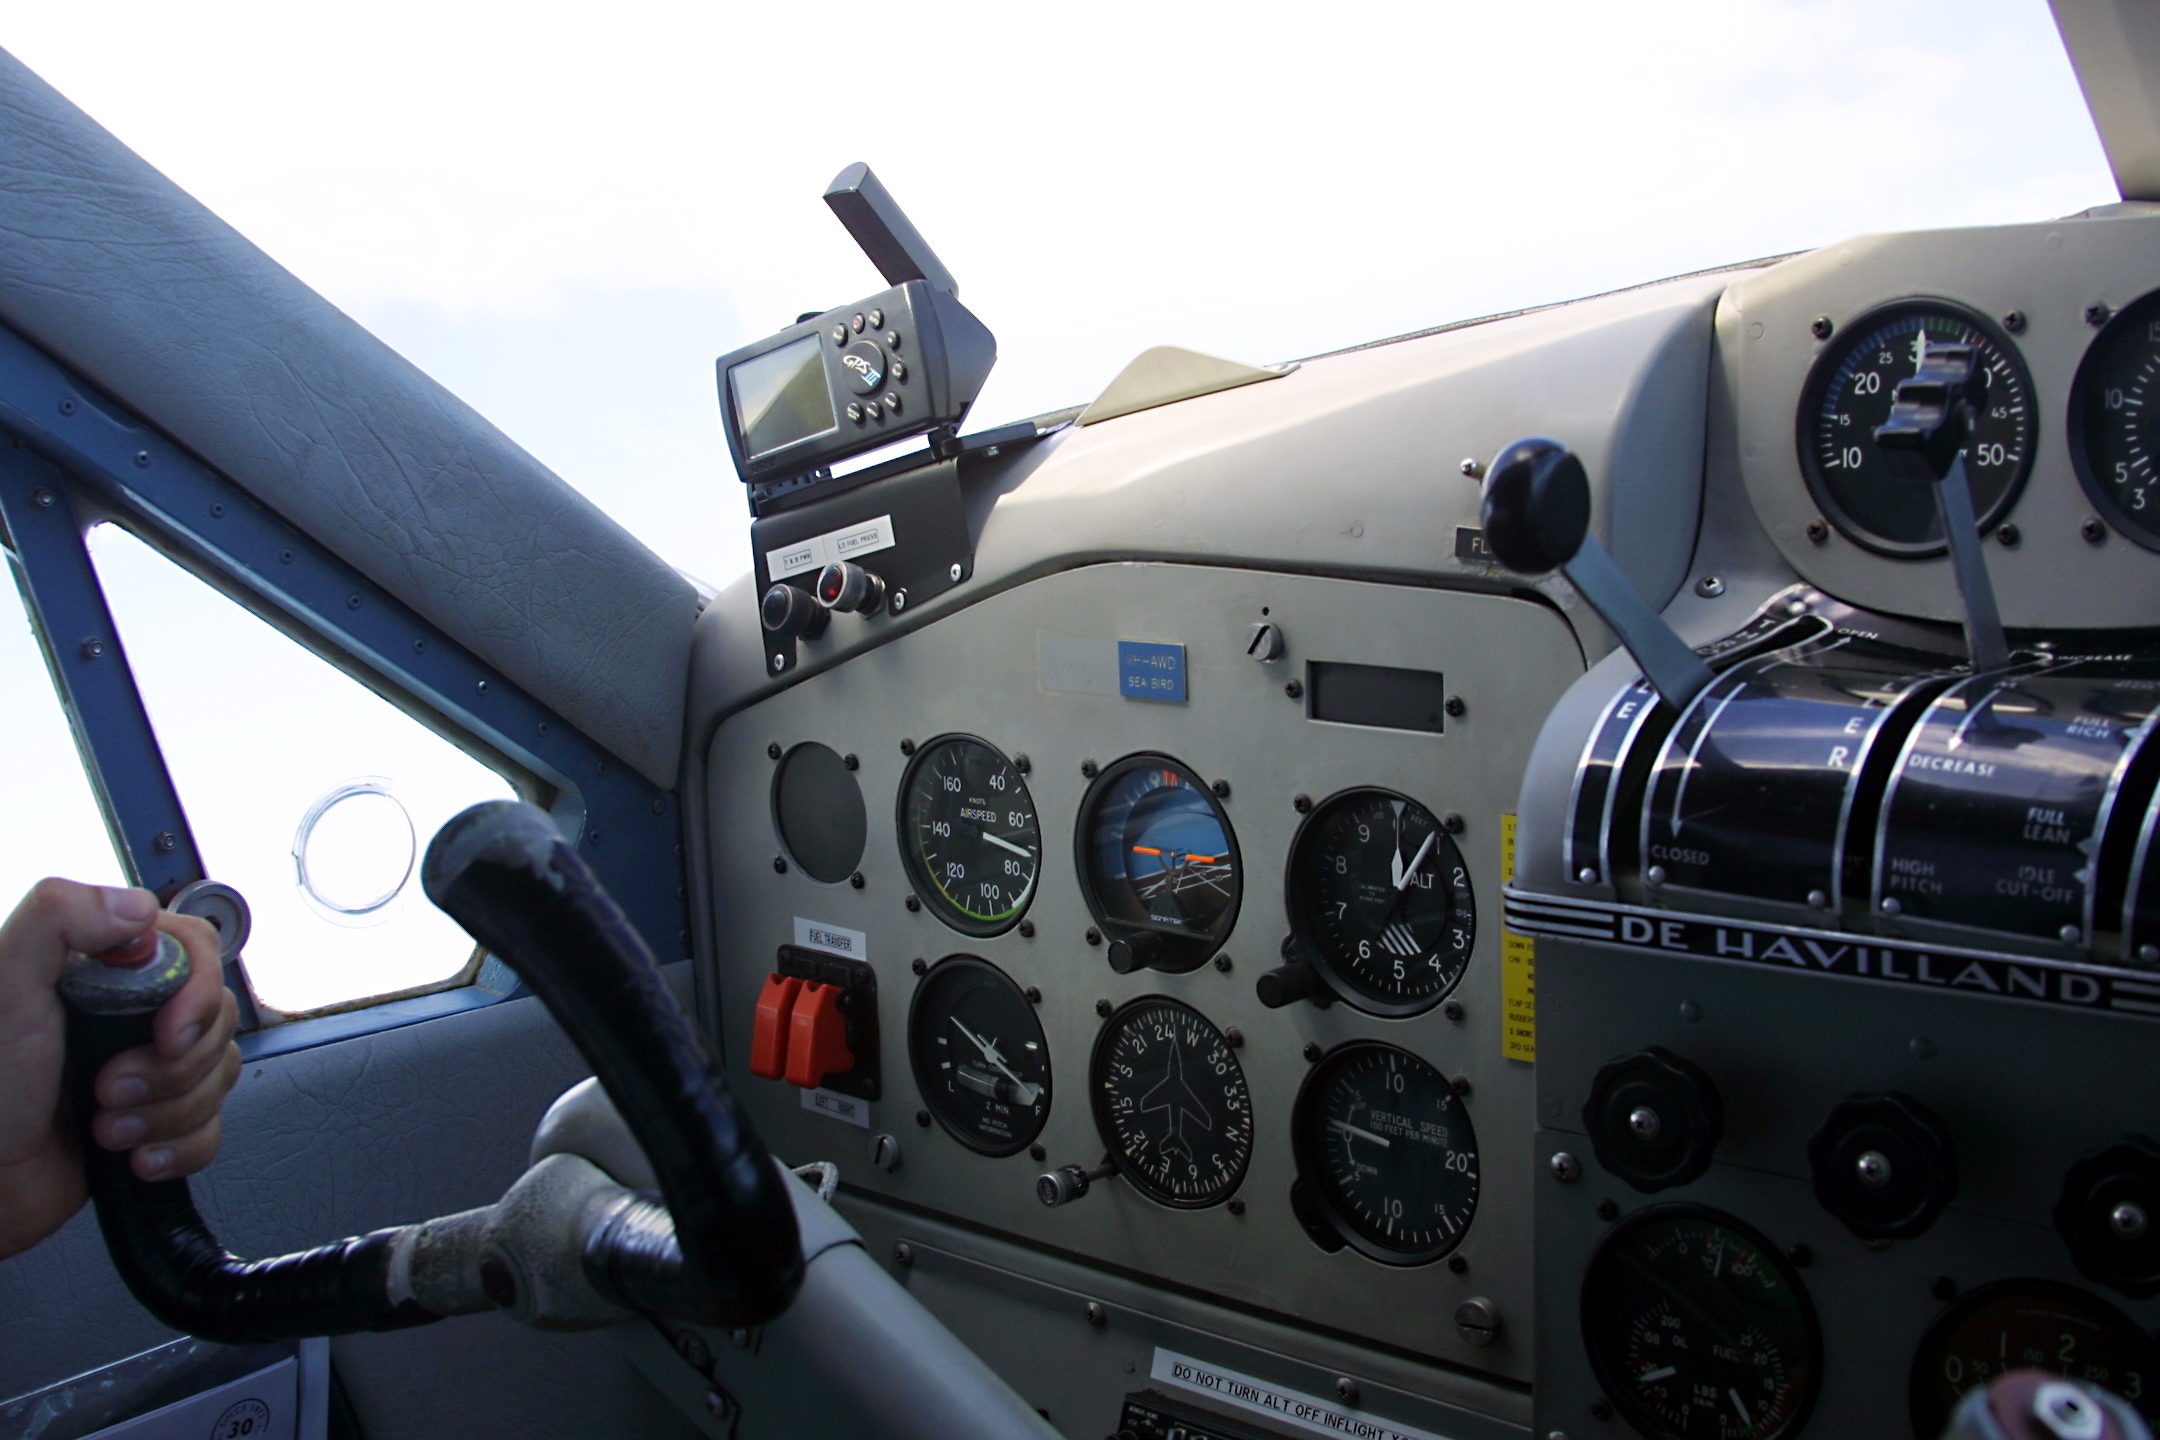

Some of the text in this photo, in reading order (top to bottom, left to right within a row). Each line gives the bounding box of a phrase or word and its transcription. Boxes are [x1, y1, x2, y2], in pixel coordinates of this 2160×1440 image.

[843, 355, 871, 374] GPS
[1879, 352, 1893, 364] 25
[1854, 372, 1880, 394] 20
[2105, 388, 2123, 410] 10
[1840, 414, 1851, 426] 15
[1842, 446, 1862, 468] 10
[1977, 443, 2004, 466] 50
[2114, 462, 2128, 484] 5
[2132, 488, 2145, 510] 3
[1837, 628, 1879, 640] OPEN
[1128, 676, 1174, 691] SEA BIRD
[2066, 724, 2110, 739] RICH
[1909, 752, 1997, 778] DECREASE
[943, 775, 961, 793] 160
[989, 775, 1005, 790] 40
[960, 807, 997, 823] AIRSPEED
[1008, 811, 1024, 828] 60
[2026, 806, 2067, 827] FULL
[932, 820, 950, 837] 140
[1358, 823, 1370, 843] 9
[2022, 823, 2070, 845] LEAN
[1336, 855, 1347, 874] 8
[1650, 844, 1710, 866] CLOSED
[946, 862, 965, 879] 120
[1004, 860, 1020, 876] 80
[1453, 866, 1465, 887] 2
[1892, 857, 1936, 877] HIGH
[2018, 864, 2056, 885] IDLE
[1409, 870, 1434, 889] ALT
[1890, 874, 1943, 896] PITCH
[980, 883, 1000, 900] 100
[1996, 878, 2074, 904] CUT-OFF
[1336, 901, 1348, 920] 7
[810, 930, 823, 943] FUEL
[1452, 928, 1465, 949] 3
[1358, 940, 1370, 959] 6
[1428, 953, 1442, 972] 4
[1621, 915, 2101, 1004] DE HAVILLAND
[1393, 960, 1405, 980] 5
[1154, 1024, 1175, 1041] 24
[1186, 1028, 1200, 1048] W
[1132, 1034, 1148, 1054] 21
[1120, 1064, 1132, 1078] S
[1208, 1050, 1226, 1076] 30
[1386, 1071, 1404, 1093] 10
[815, 1094, 828, 1108] LEFT
[1224, 1085, 1240, 1111] 33
[1354, 1090, 1361, 1100] 5
[1436, 1099, 1447, 1111] 15
[1370, 1110, 1448, 1138] VERTICAL SPEED
[1225, 1126, 1240, 1142] N
[1384, 1124, 1403, 1136] FEET
[1404, 1128, 1420, 1141] PER
[1422, 1133, 1448, 1148] MINUTE
[1212, 1153, 1224, 1170] 3
[1444, 1150, 1468, 1172] 20
[1188, 1164, 1198, 1180] 6
[1354, 1170, 1361, 1181] 5
[1384, 1196, 1402, 1218] 10
[1435, 1202, 1446, 1215] 15
[1678, 1242, 1688, 1254] 0
[1731, 1262, 1753, 1277] 100
[1661, 1314, 1681, 1330] 200
[1643, 1330, 1660, 1346] 150
[1672, 1334, 1688, 1350] OIL
[1740, 1334, 1753, 1347] 25
[2000, 1330, 2006, 1359] 1
[1712, 1344, 1739, 1361] FUEL
[2023, 1347, 2044, 1364] 150
[2058, 1333, 2076, 1364] 2
[1754, 1351, 1768, 1366] 20
[1972, 1360, 1989, 1374] 50
[1945, 1355, 1964, 1383] 0
[2083, 1364, 2109, 1382] 250
[1763, 1377, 1774, 1392] 15
[2122, 1370, 2142, 1400] 3
[1173, 1364, 1191, 1380] DO
[1195, 1371, 1223, 1390] NOT
[1228, 1382, 1259, 1403] TURN
[1263, 1394, 1290, 1413] ALT
[1296, 1404, 1319, 1421] OFF
[1323, 1412, 1384, 1440] INFLIGHT
[1681, 1403, 1690, 1416] 0
[1756, 1398, 1768, 1411] 10
[227, 1418, 254, 1438] 30
[1720, 1414, 1728, 1426] 0
